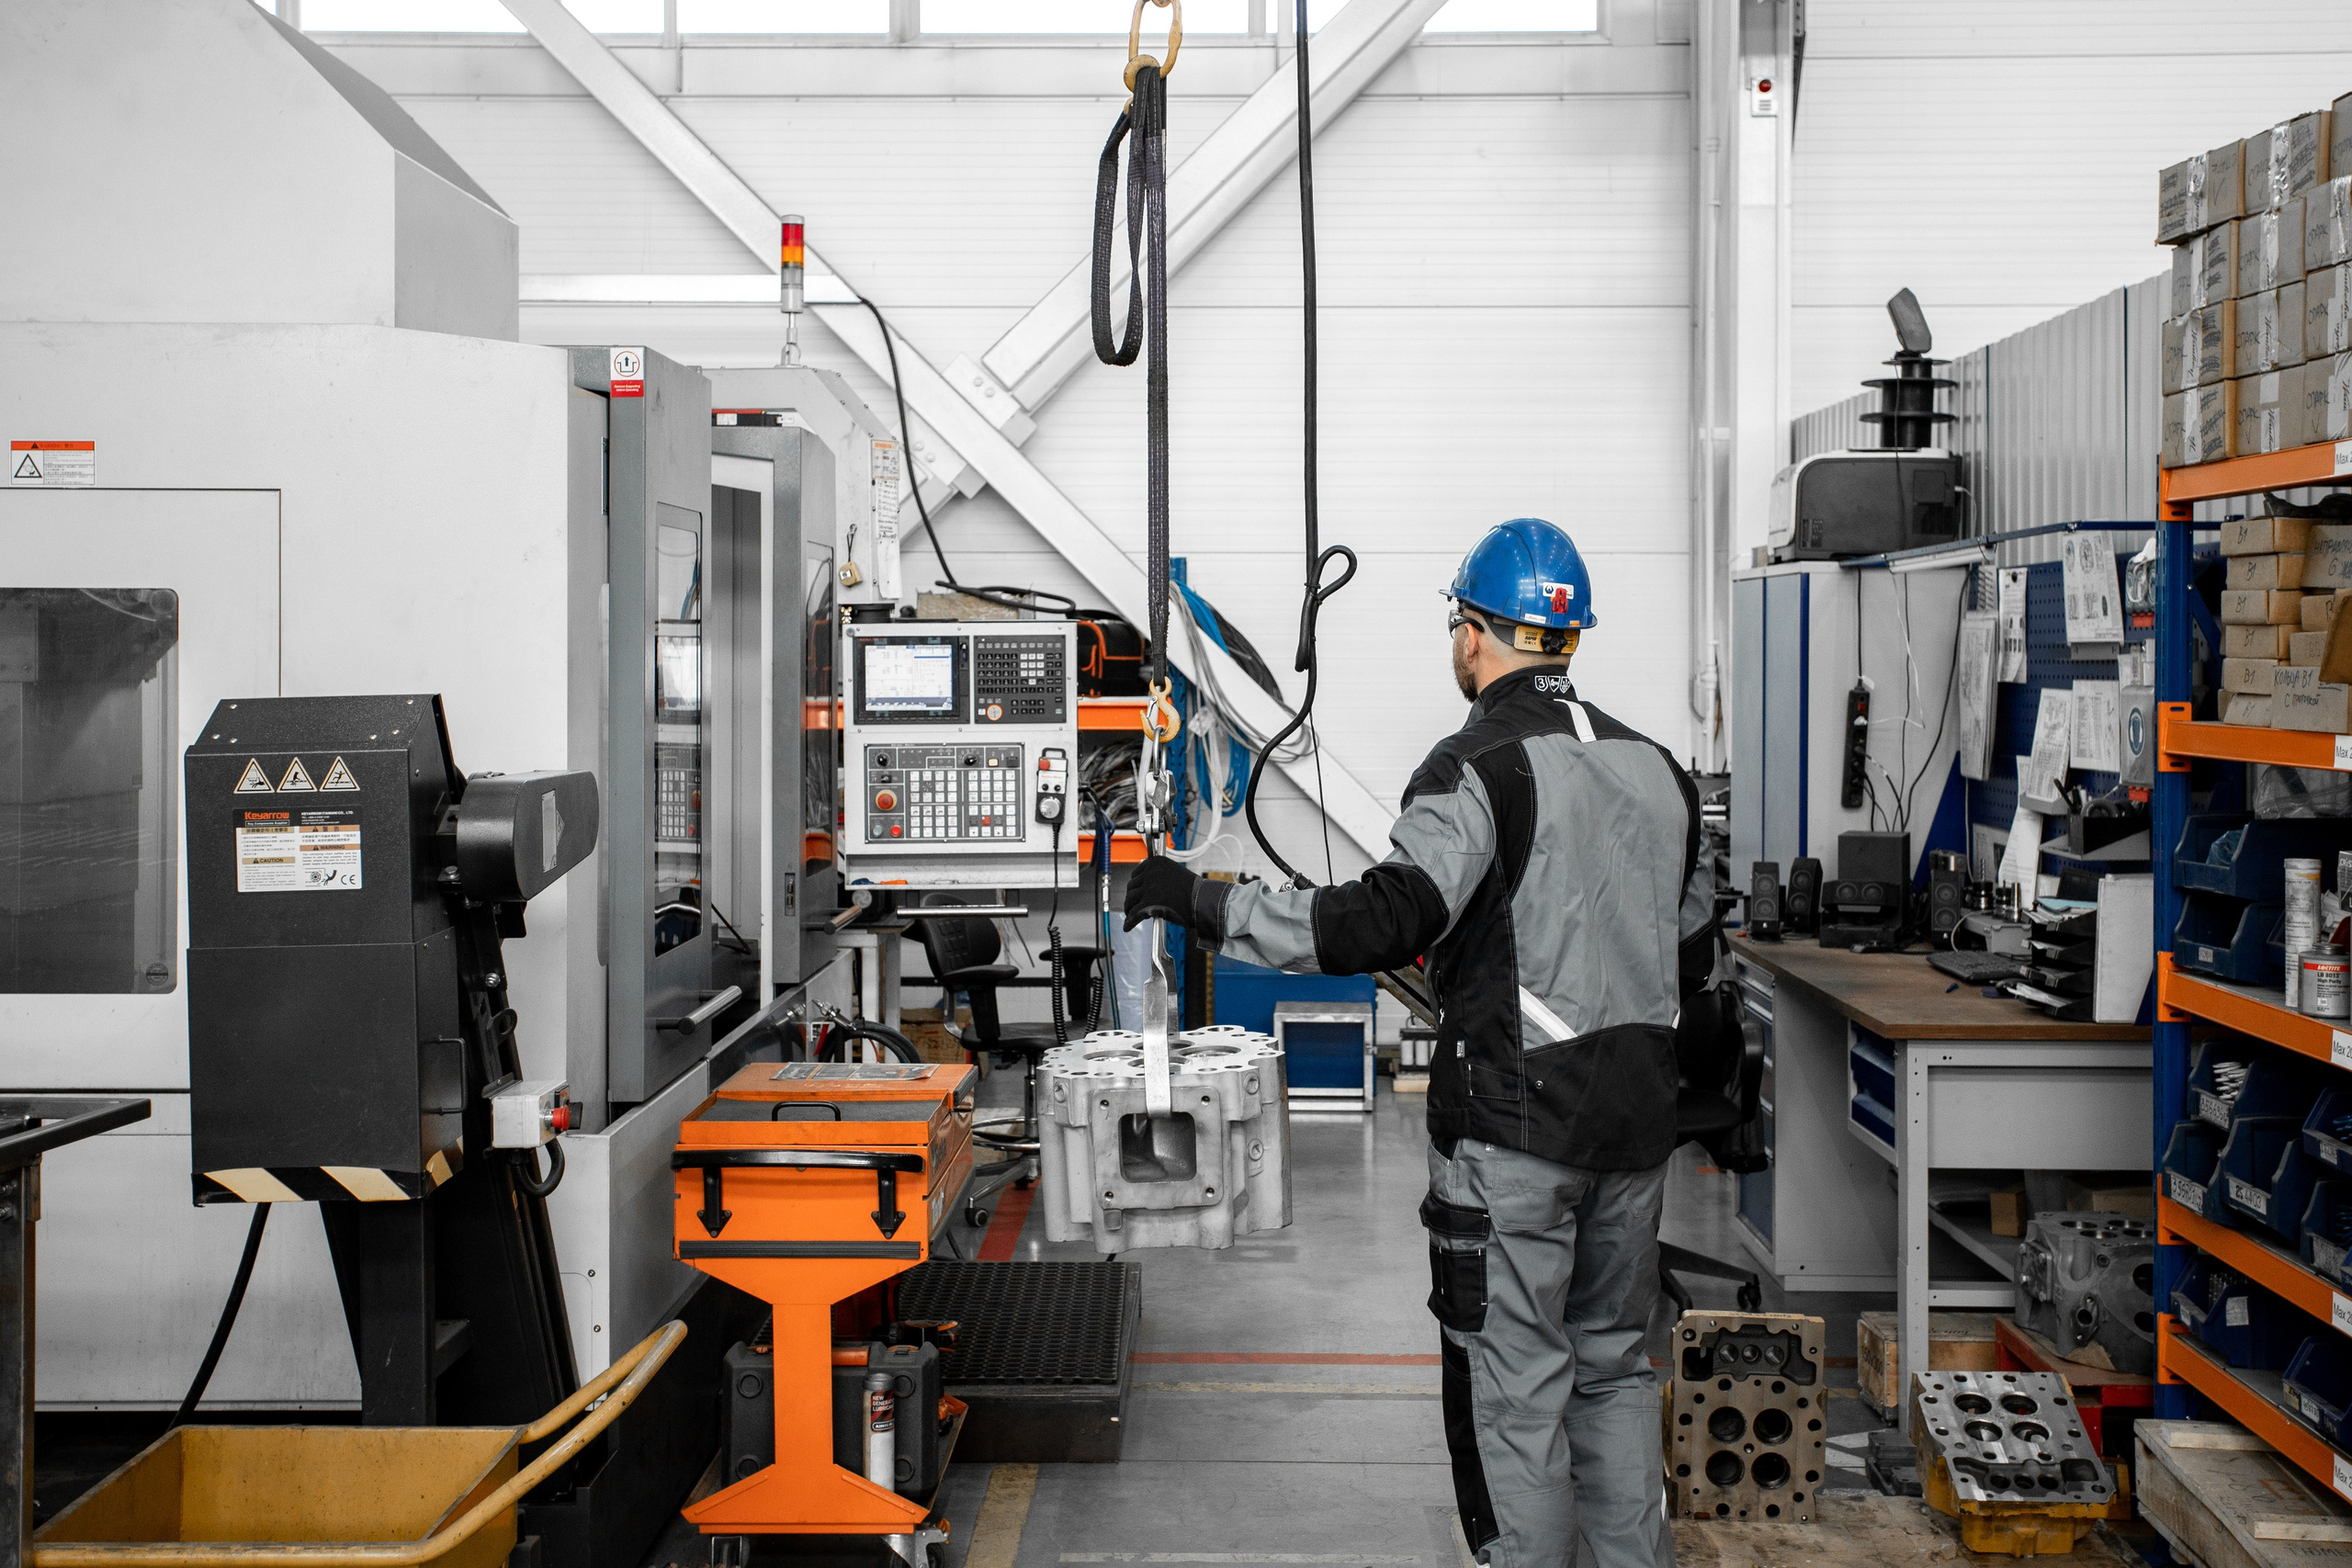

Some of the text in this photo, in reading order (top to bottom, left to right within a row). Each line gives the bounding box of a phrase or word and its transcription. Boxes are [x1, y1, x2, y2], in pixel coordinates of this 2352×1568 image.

[2336, 454, 2348, 464] Max
[2336, 747, 2348, 758] Max
[2333, 1040, 2345, 1055] Max
[2334, 1304, 2345, 1318] Max
[2335, 1467, 2347, 1483] Max
